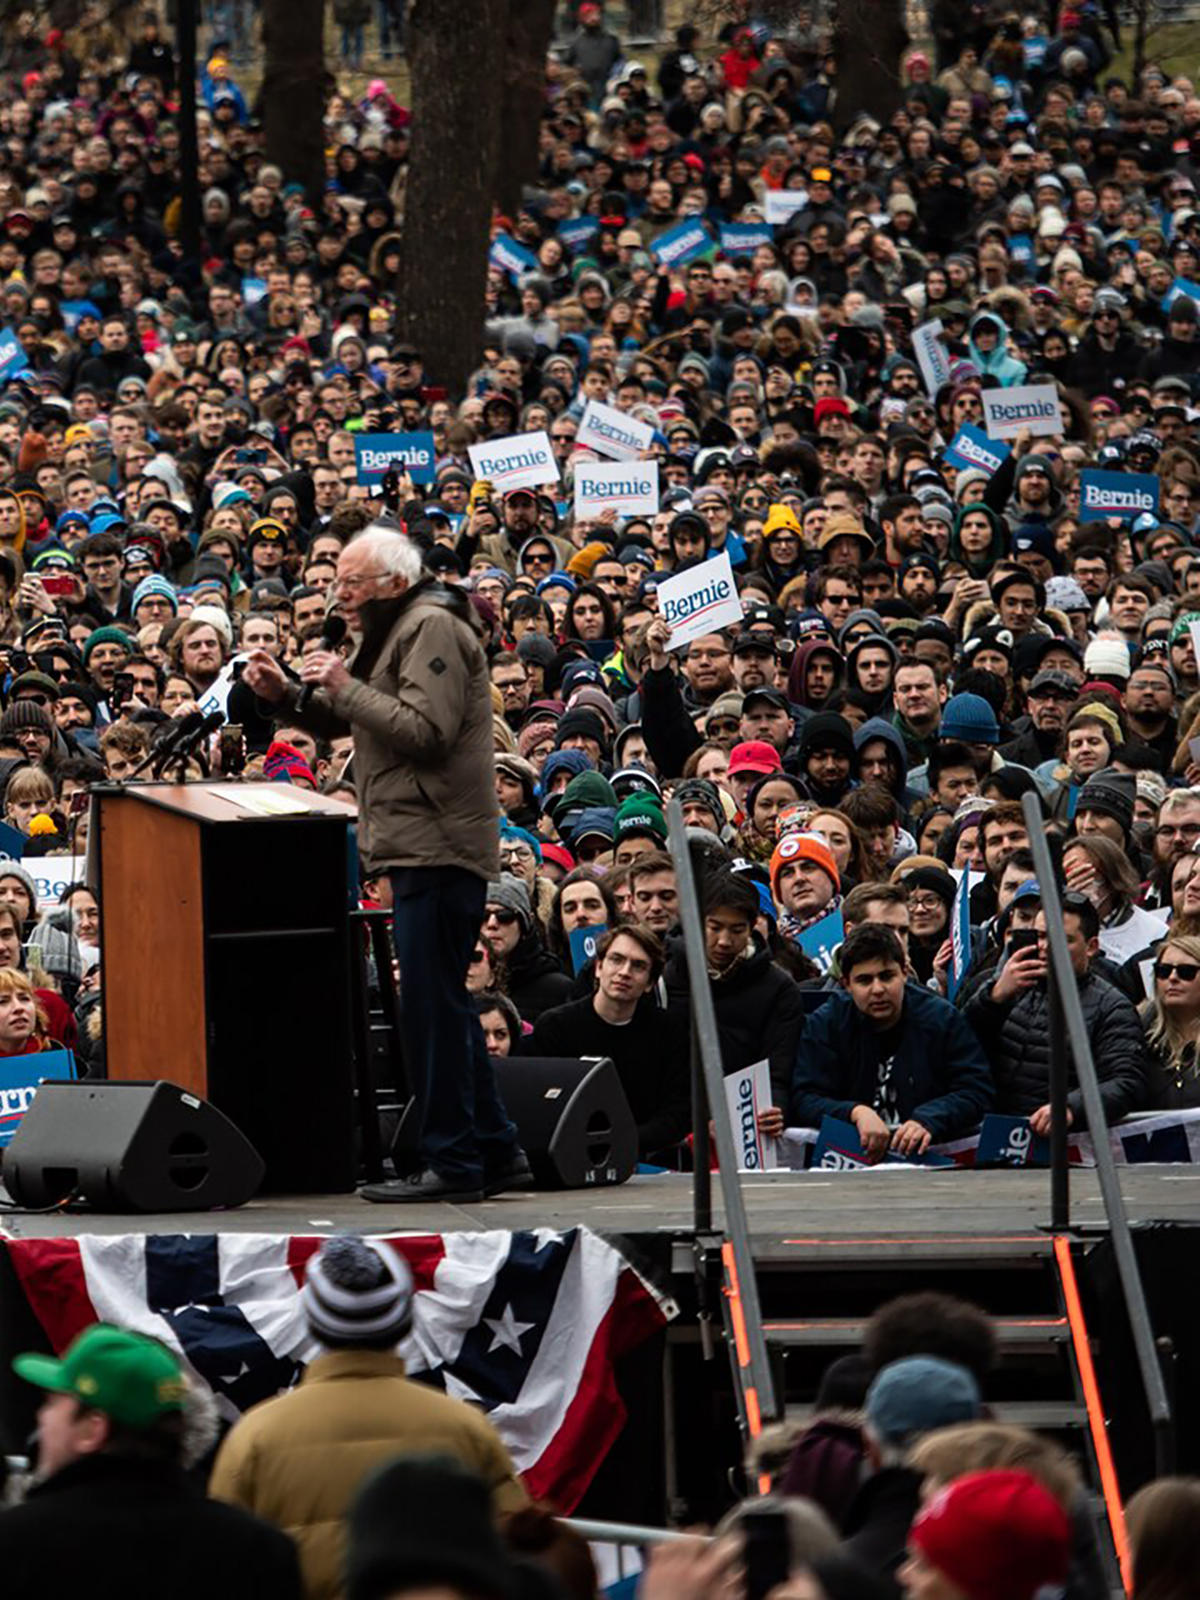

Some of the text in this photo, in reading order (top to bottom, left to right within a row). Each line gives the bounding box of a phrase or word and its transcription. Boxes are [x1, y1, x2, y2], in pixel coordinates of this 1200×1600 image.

[988, 401, 1055, 421] Bernie
[585, 415, 646, 450] Bernie
[357, 446, 430, 468] Bernie
[479, 449, 549, 477] Bernie
[581, 478, 652, 498] Bernie
[1084, 485, 1154, 509] Bernie
[662, 578, 731, 623] Bernie
[738, 1079, 761, 1170] ernie
